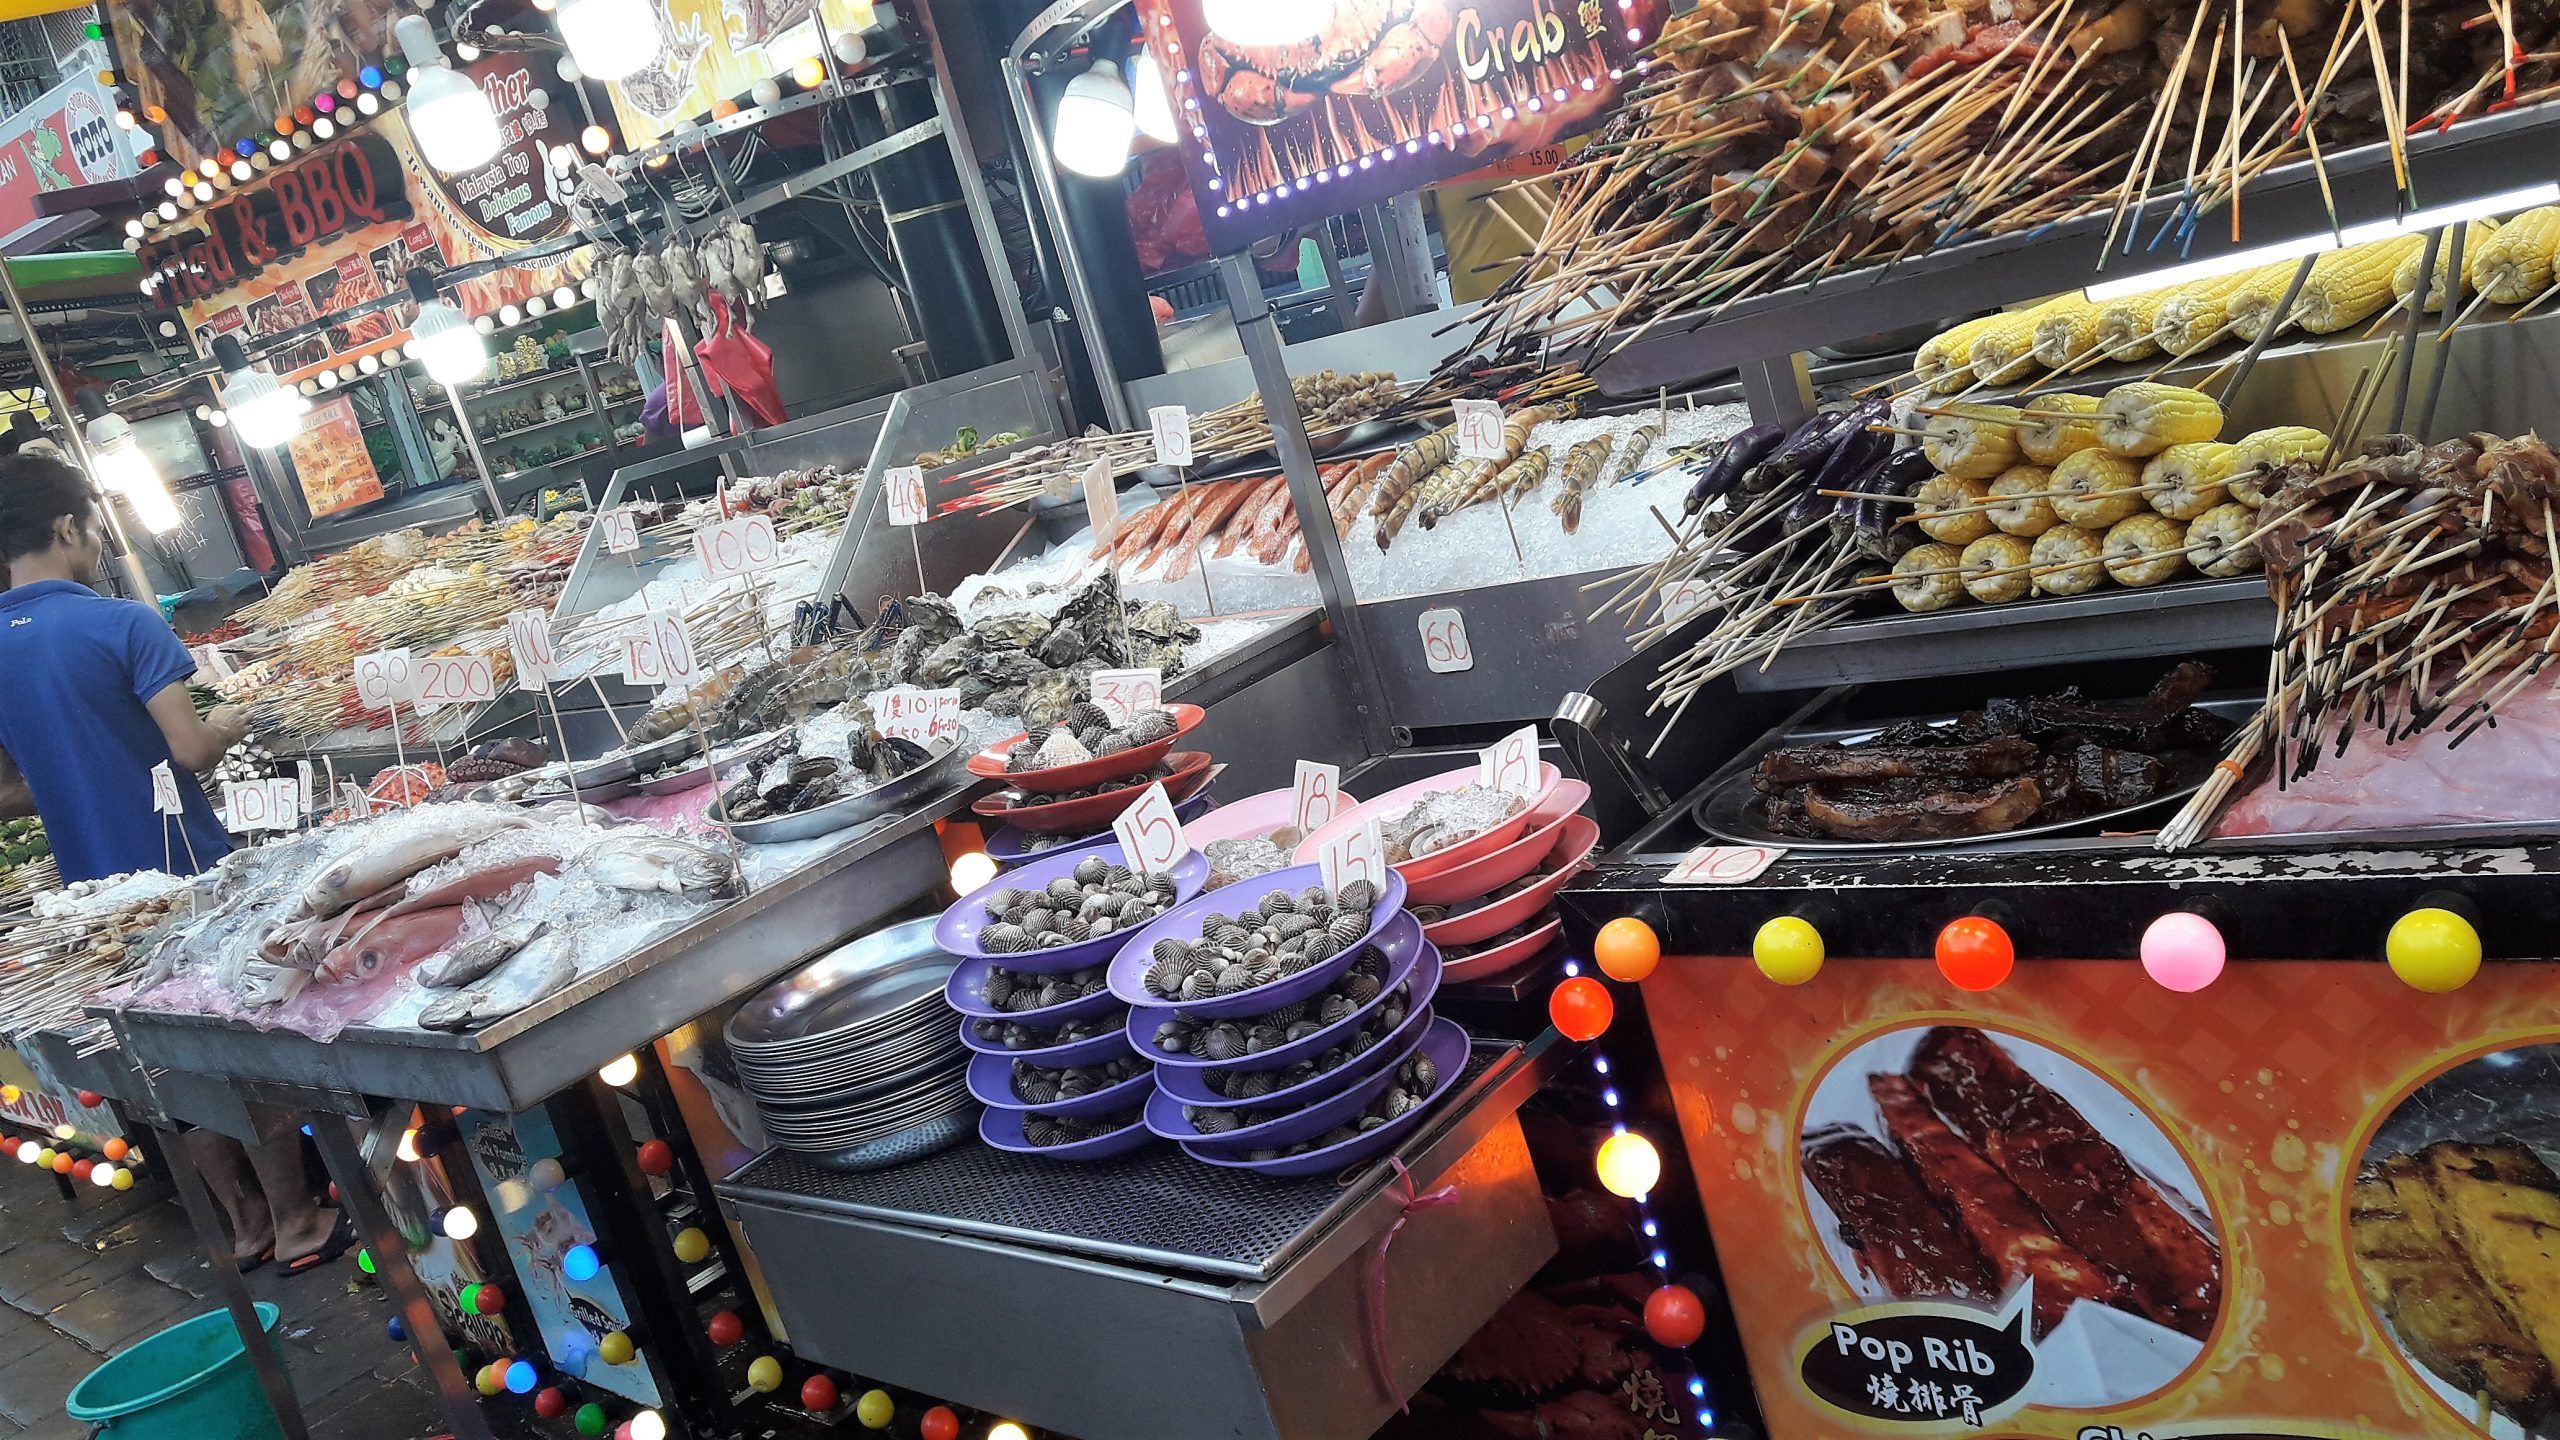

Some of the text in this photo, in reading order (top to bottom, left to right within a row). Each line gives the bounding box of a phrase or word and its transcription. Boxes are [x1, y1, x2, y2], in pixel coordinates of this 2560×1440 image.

[1456, 8, 1565, 80] Crab
[70, 116, 114, 168] TOTO
[1530, 150, 1559, 166] 15.00
[419, 175, 446, 215] want
[456, 163, 504, 204] Malaysia
[503, 151, 530, 177] Top
[233, 195, 280, 266] &
[269, 139, 385, 246] BBQ
[479, 182, 532, 222] Delicious
[505, 201, 551, 235] Famous
[1158, 412, 1184, 456] 15
[1464, 407, 1501, 454] 40
[603, 511, 636, 549] 25
[698, 521, 773, 575] 100
[511, 617, 550, 670] 100
[653, 617, 690, 679] 10
[1427, 621, 1468, 661] 60
[362, 656, 408, 700] 80
[420, 660, 490, 698] 200
[1098, 681, 1157, 724] 30
[1492, 738, 1527, 792] 18
[233, 788, 265, 825] 10
[273, 785, 293, 822] 15
[1298, 771, 1331, 834] 18
[1125, 796, 1176, 875] 15
[1684, 848, 1766, 878] 10
[570, 1303, 602, 1327] Grilled
[1832, 1324, 1995, 1376] Pop Rib
[1622, 1370, 1680, 1440] 燒
[1866, 1373, 1984, 1428] 燒排骨
